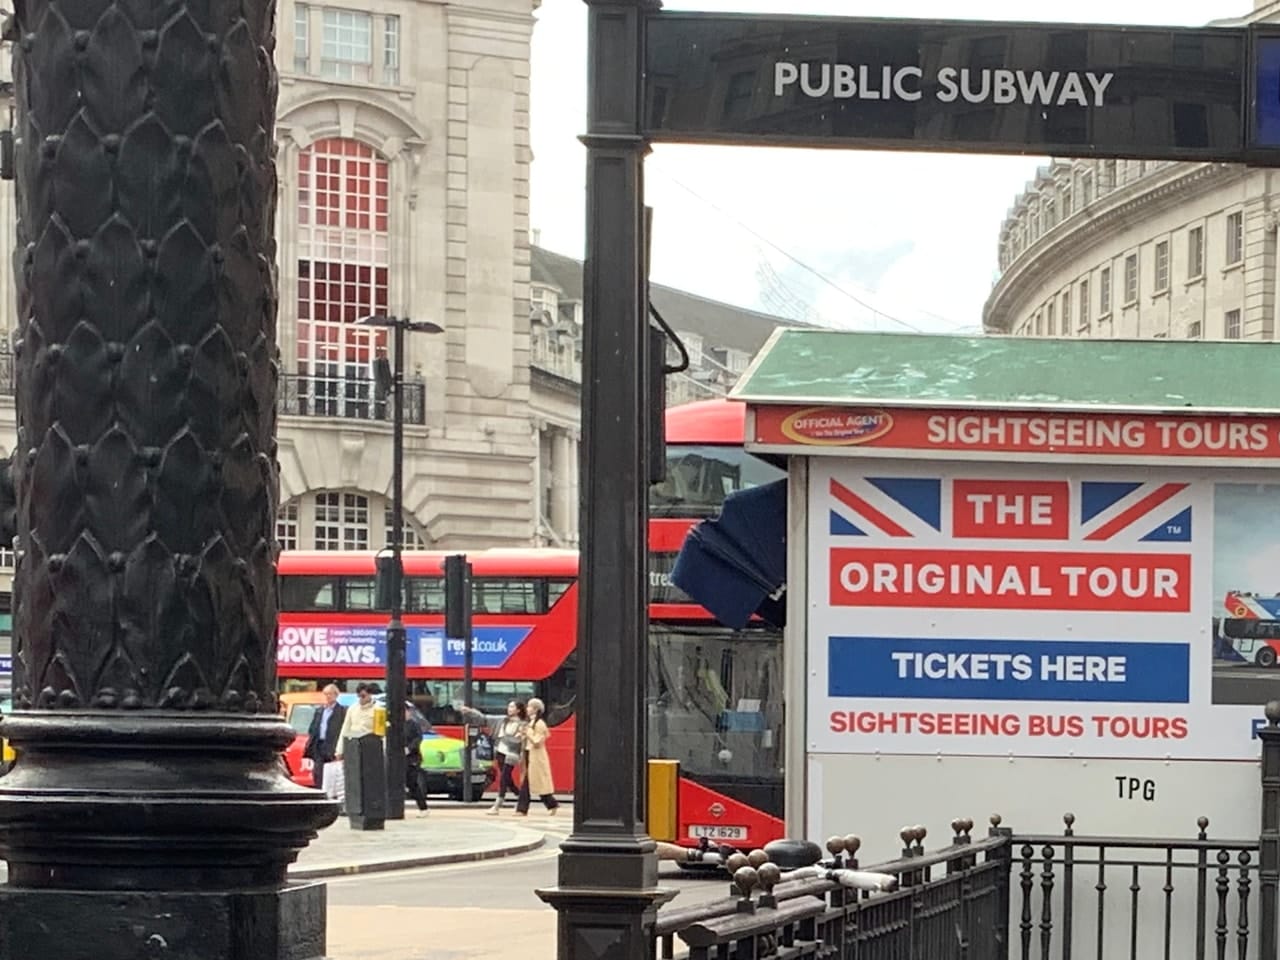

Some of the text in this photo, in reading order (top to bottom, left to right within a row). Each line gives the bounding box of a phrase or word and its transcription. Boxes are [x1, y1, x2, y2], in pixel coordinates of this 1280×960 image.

[773, 62, 1114, 107] PUBLIC SUBWAY
[793, 414, 884, 430] OFFICIAL AGENT
[926, 415, 1147, 448] SIGHTSEEING
[1156, 421, 1271, 450] TOURS
[966, 494, 1054, 525] THE
[1166, 525, 1183, 535] TM
[839, 562, 1180, 599] ORIGINAL TOUR
[278, 627, 328, 645] OVE
[892, 652, 1127, 682] TICKETS HERE
[829, 711, 1189, 739] SIGHTSEEING BUS TOURS
[1115, 775, 1157, 801] TPG
[694, 826, 716, 838] LTZ
